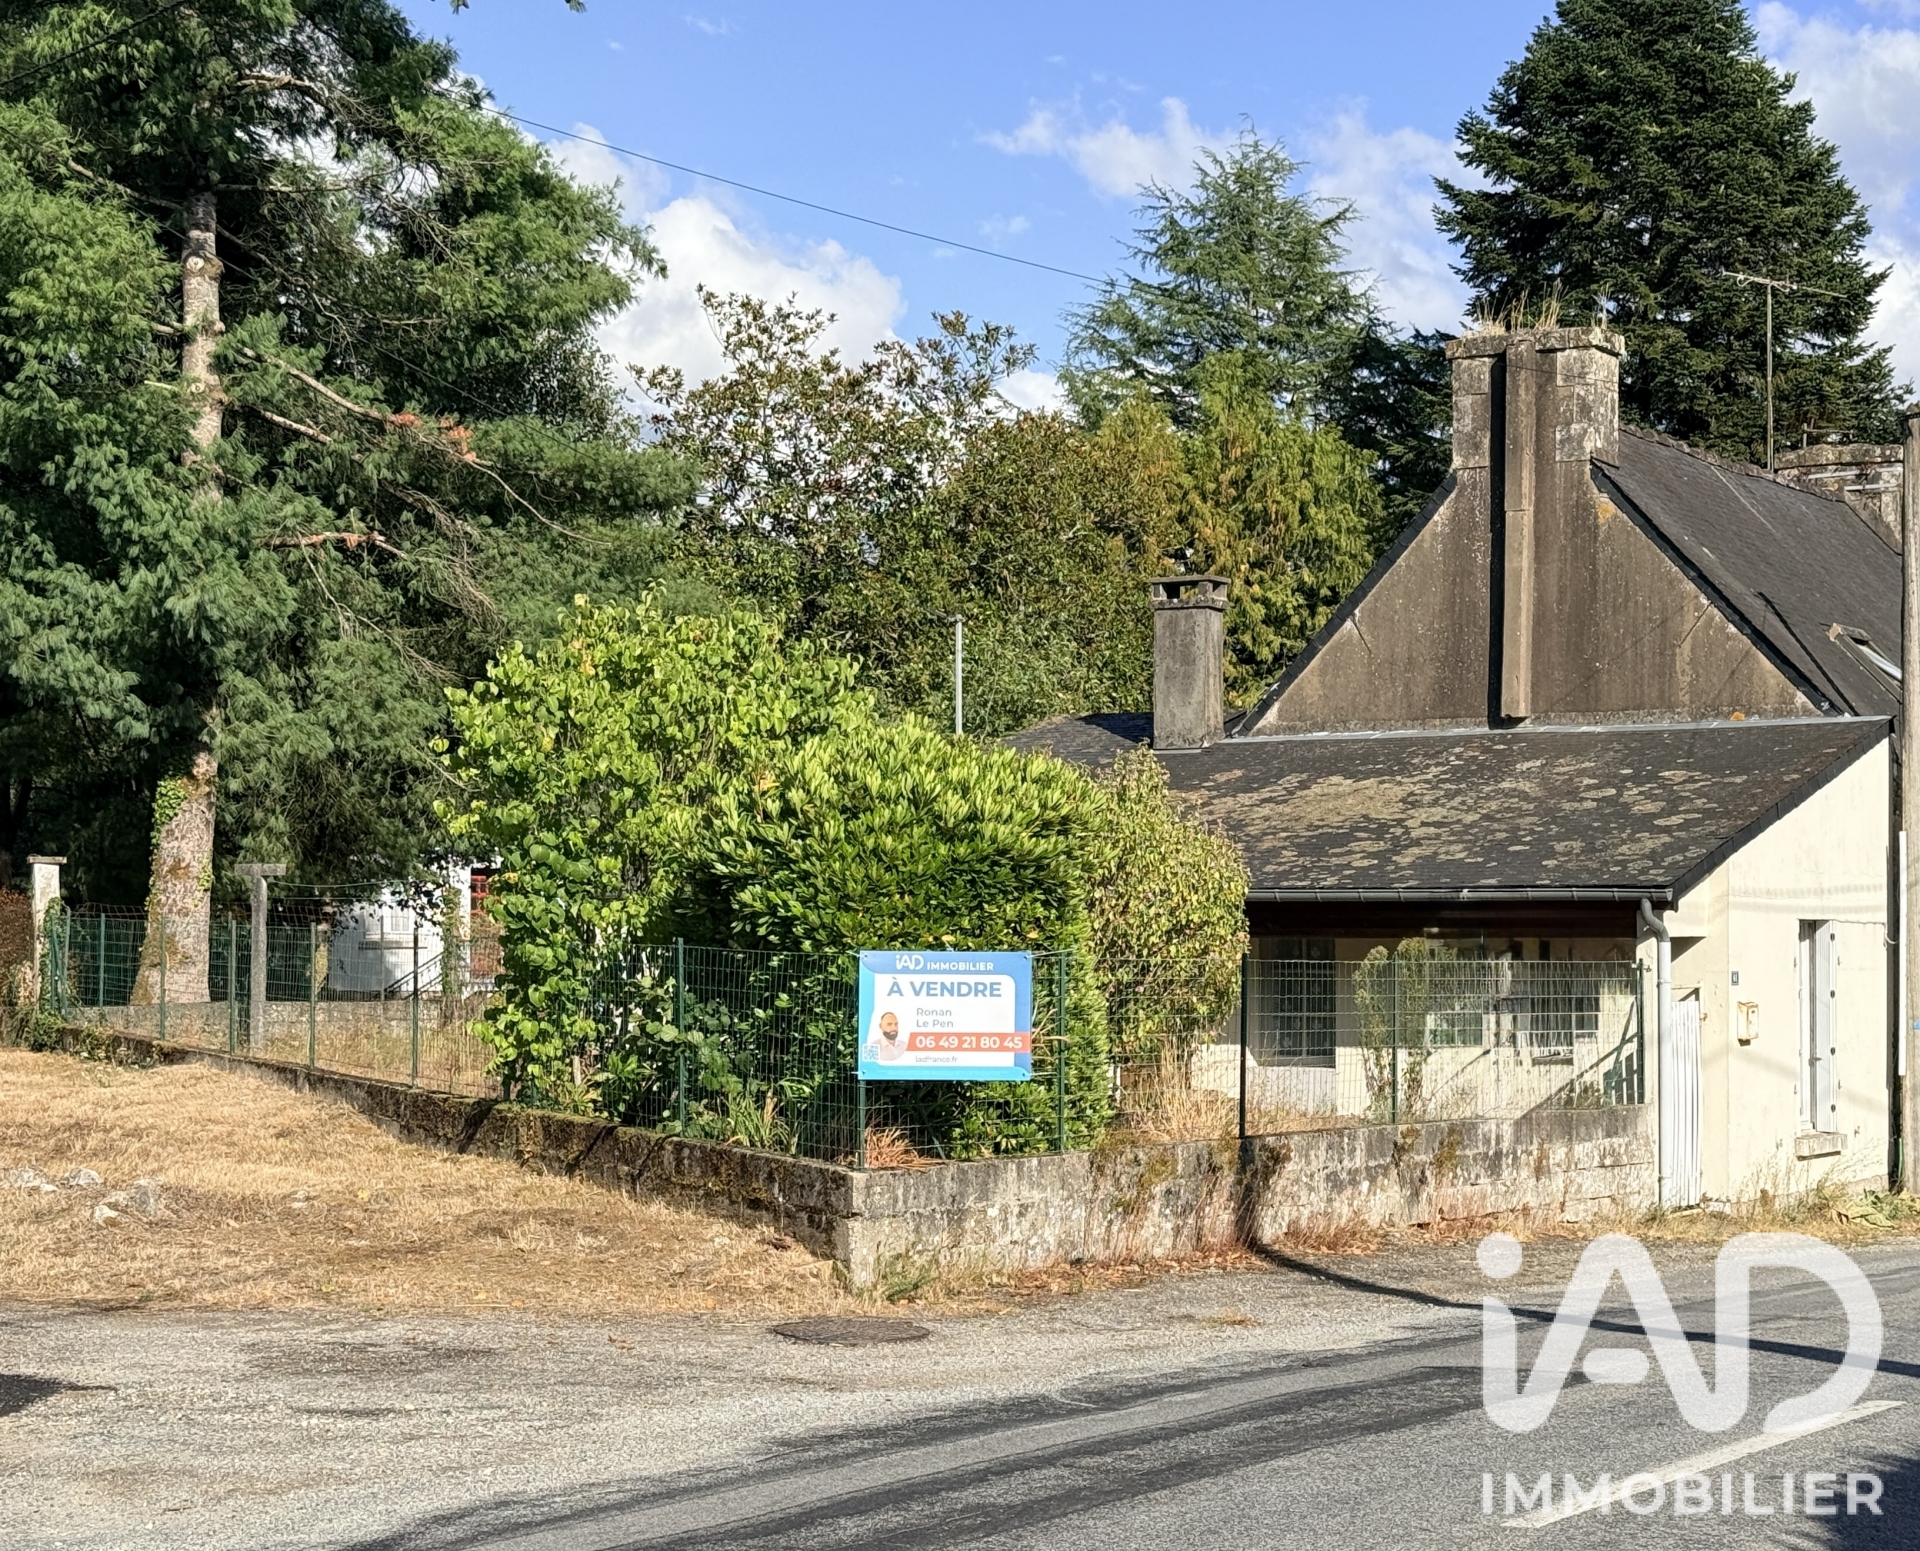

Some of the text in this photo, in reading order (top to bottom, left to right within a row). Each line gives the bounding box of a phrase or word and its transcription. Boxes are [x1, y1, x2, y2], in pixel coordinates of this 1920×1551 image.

[927, 961, 994, 971] IMMOBILIER
[887, 976, 1002, 998] À VENDRE
[916, 1008, 952, 1017] Ronan
[916, 1019, 954, 1028] Le Pen
[915, 1036, 1023, 1049] 06 49 21 80 45
